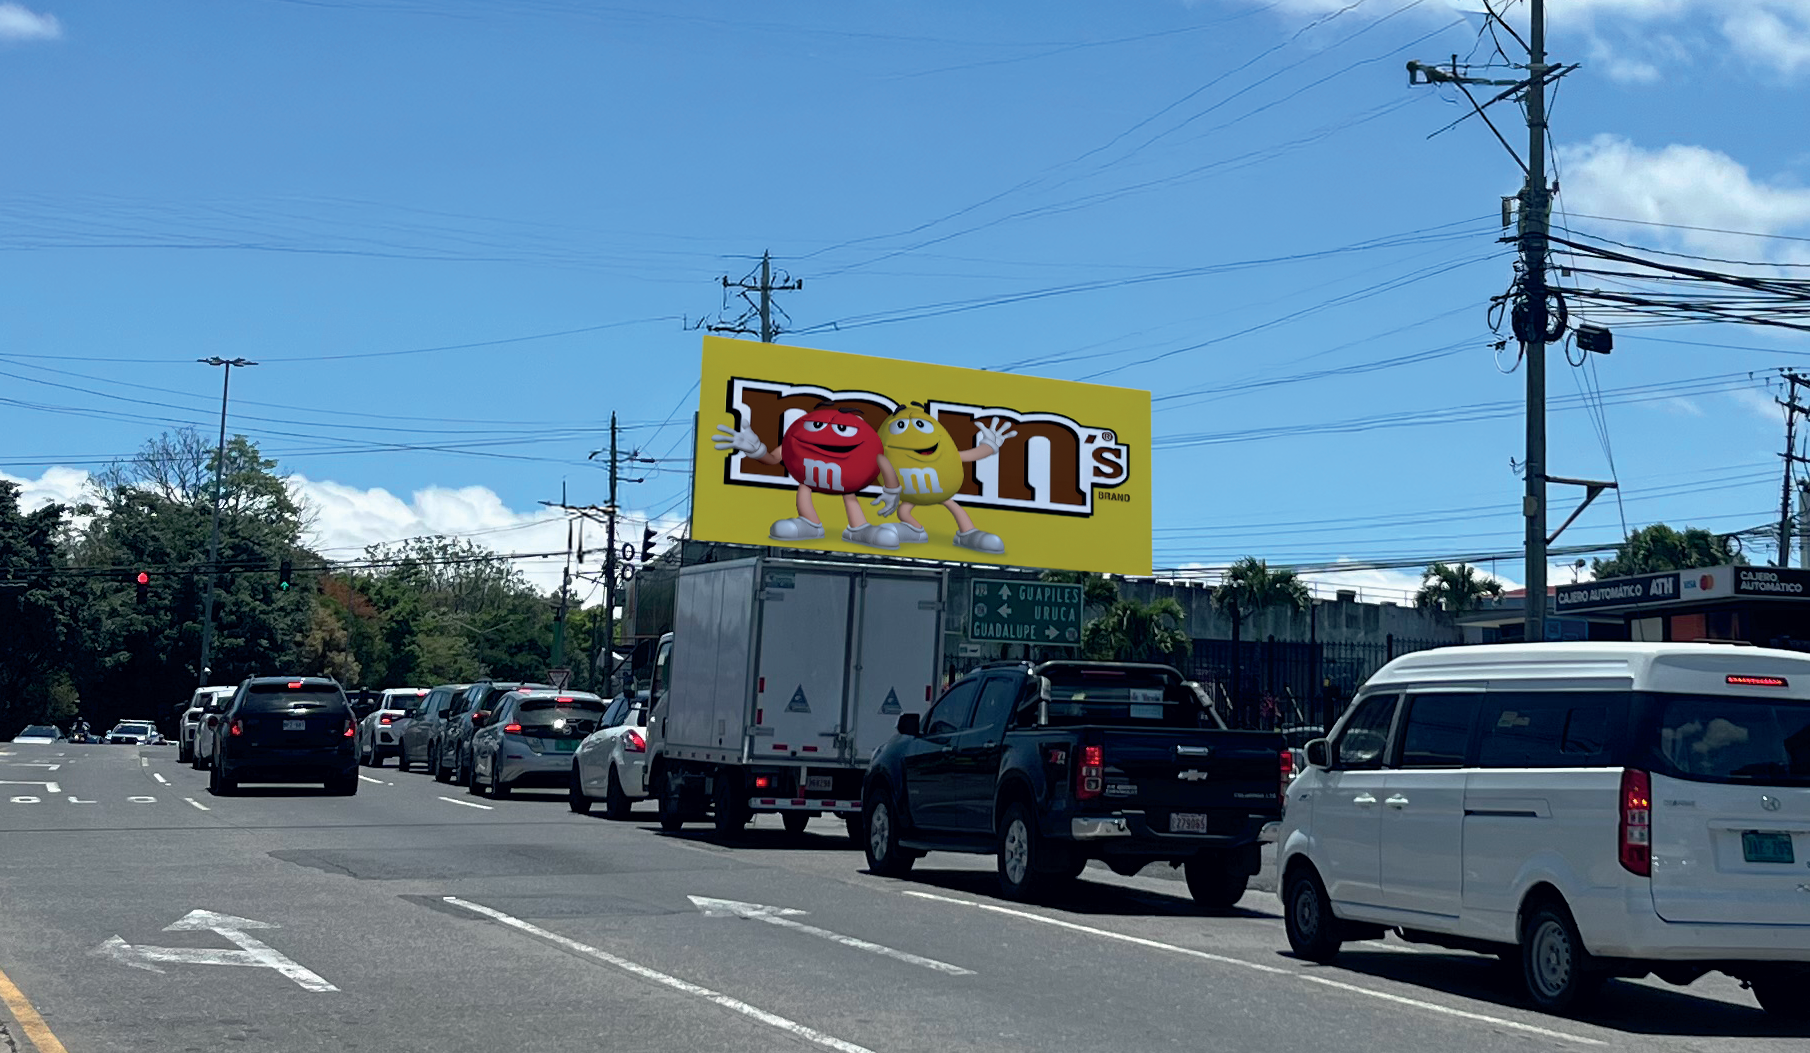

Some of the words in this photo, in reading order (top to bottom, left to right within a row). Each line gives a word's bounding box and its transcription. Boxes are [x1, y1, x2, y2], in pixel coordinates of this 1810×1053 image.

[803, 458, 844, 491] m
[899, 467, 943, 494] m
[1098, 491, 1131, 502] BRAND
[1740, 570, 1778, 582] CAJERO
[1019, 585, 1079, 603] GUAPILES
[1557, 590, 1588, 605] CAJERO
[1589, 583, 1643, 601] AUTOMÁTICO
[1649, 577, 1675, 596] ATH
[1034, 606, 1076, 622] URUCA
[973, 622, 1037, 639] GUADALUPE
